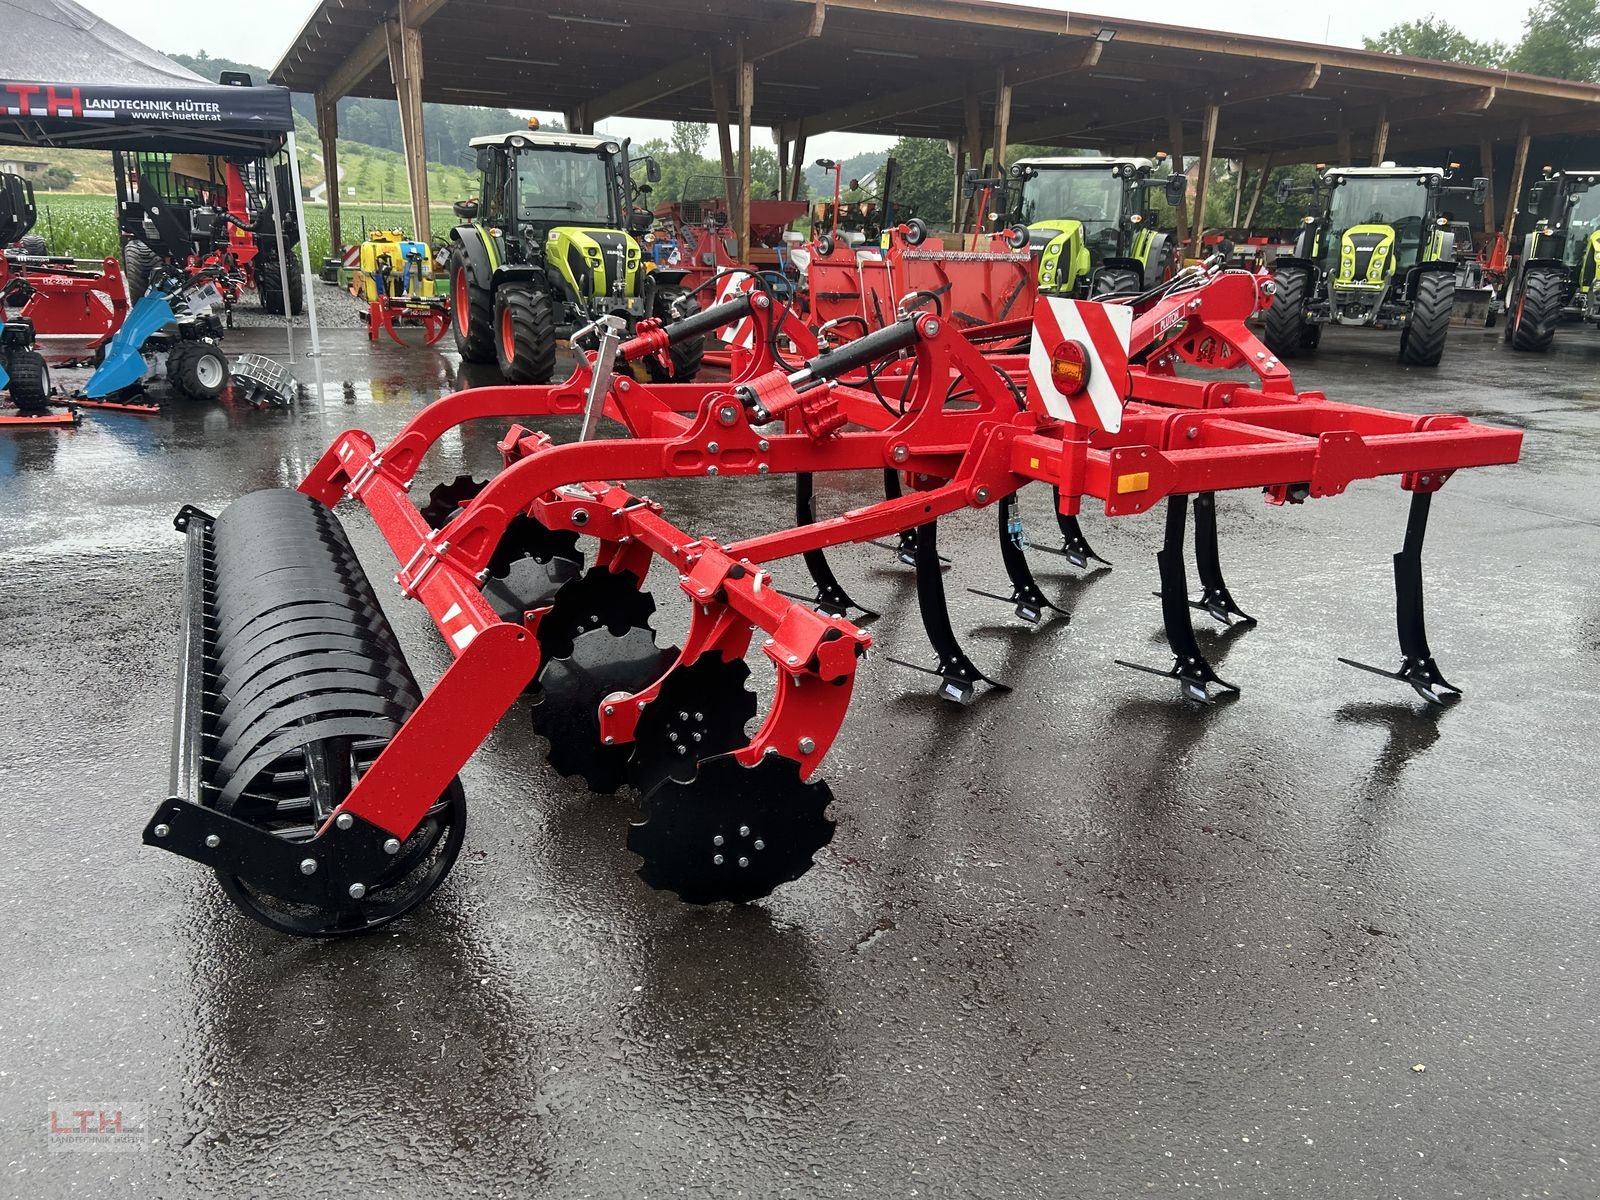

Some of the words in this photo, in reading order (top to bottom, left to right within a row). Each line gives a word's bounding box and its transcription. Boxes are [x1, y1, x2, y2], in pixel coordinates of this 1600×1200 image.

[0, 84, 83, 118] TH
[85, 98, 173, 111] LANDTECHNIK
[175, 99, 220, 113] HÜTTER
[131, 111, 222, 121] www.lt-huetter.at
